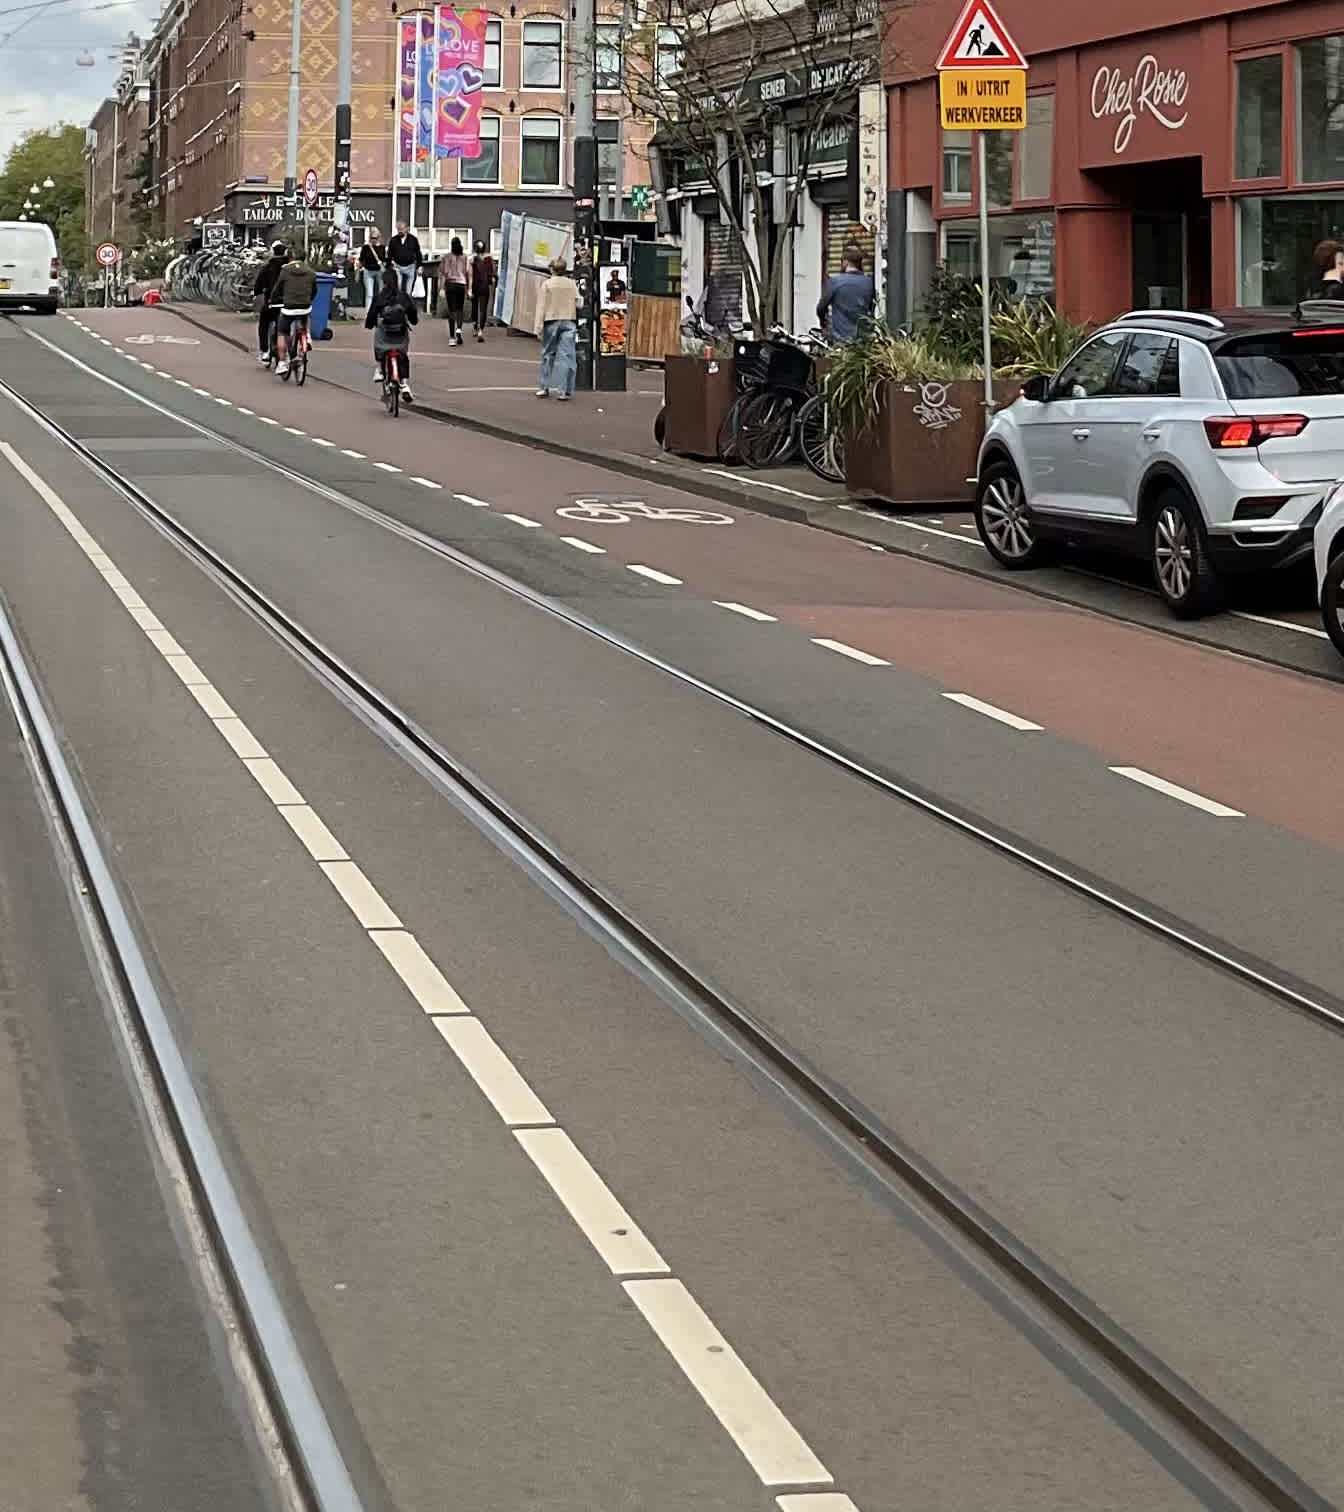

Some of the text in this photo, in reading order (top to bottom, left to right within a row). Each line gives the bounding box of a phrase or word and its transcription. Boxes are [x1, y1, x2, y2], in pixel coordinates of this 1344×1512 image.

[443, 39, 481, 54] LOVE
[956, 79, 968, 96] IN
[975, 79, 1010, 96] UITRIT
[1091, 54, 1189, 154] Chez Rosie
[945, 106, 1023, 123] WERKVERKEER
[243, 208, 283, 222] TAILOR
[320, 209, 375, 223] CLNING
